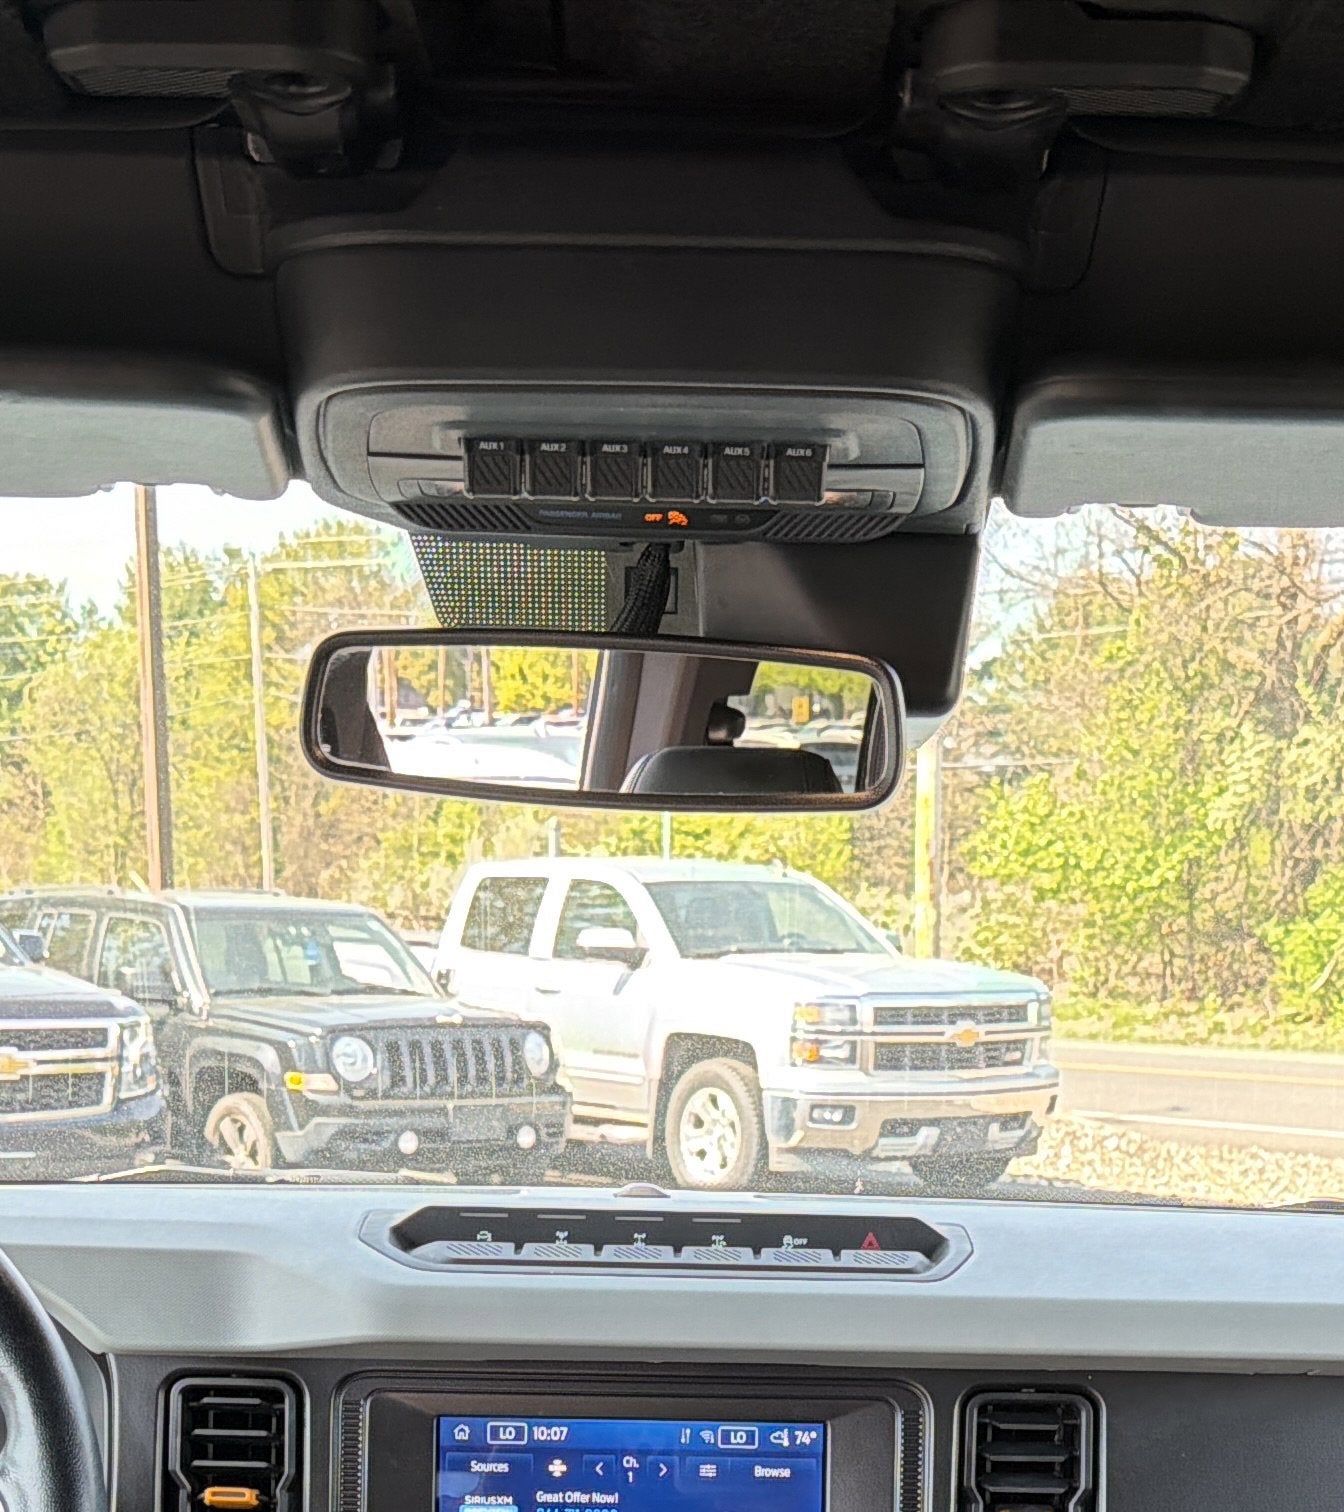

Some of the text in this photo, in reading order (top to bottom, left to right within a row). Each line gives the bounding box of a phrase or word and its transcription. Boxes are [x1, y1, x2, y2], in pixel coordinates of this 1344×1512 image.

[644, 514, 663, 522] OFF
[794, 1238, 808, 1246] OFF
[499, 1426, 568, 1441] LO 10:07
[730, 1431, 817, 1446] LO 74°
[470, 1460, 509, 1473] Sources
[623, 1456, 640, 1469] Ch.
[754, 1465, 791, 1478] Browse
[536, 1491, 619, 1504] Great Offer Now!
